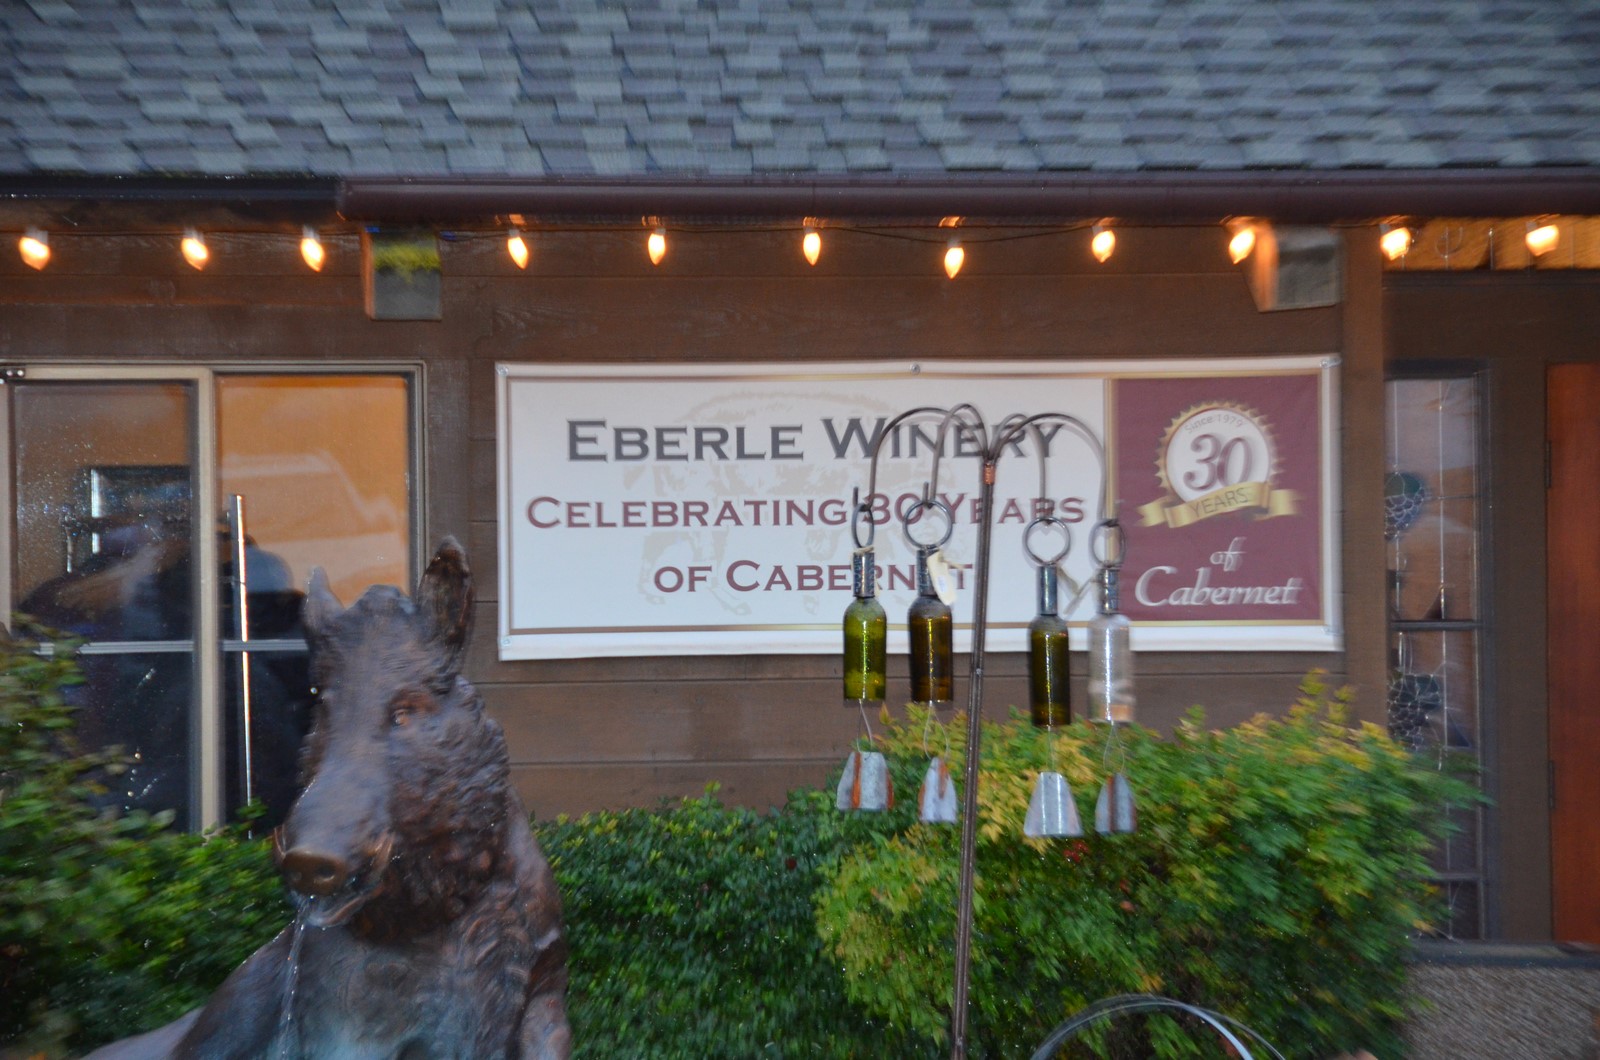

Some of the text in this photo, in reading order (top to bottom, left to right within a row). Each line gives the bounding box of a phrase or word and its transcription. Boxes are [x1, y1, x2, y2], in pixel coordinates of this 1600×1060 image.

[566, 416, 1065, 463] EBERLE WINERY
[1183, 433, 1250, 491] 30
[526, 496, 848, 529] CELEBRATING
[861, 492, 925, 526] 30
[1190, 487, 1250, 519] YEARS
[1209, 536, 1247, 572] of
[653, 559, 973, 593] OF CABENT
[1134, 565, 1303, 607] Cabernet
